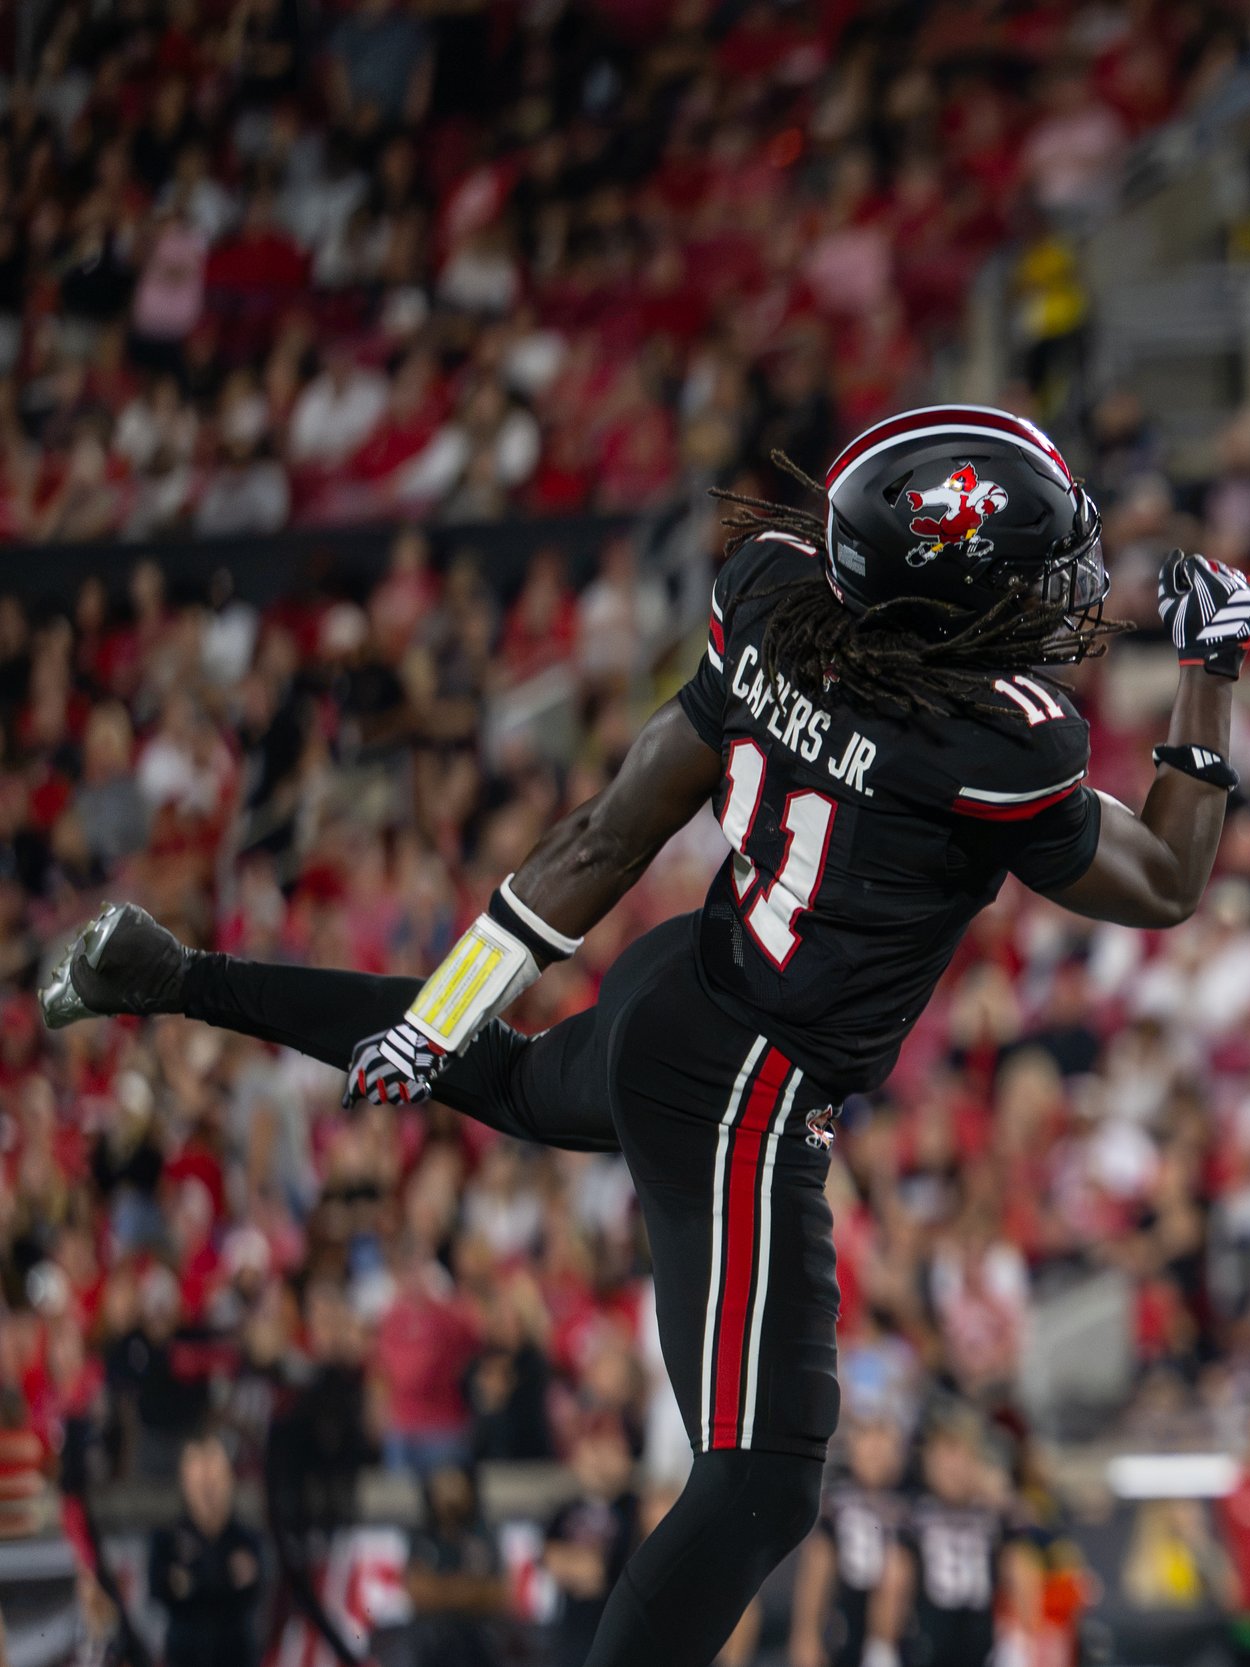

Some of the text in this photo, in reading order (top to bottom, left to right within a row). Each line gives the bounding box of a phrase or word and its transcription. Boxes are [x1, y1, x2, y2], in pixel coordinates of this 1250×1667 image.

[732, 645, 874, 797] CAPERS JR.
[992, 674, 1067, 727] 11
[721, 737, 838, 972] 11
